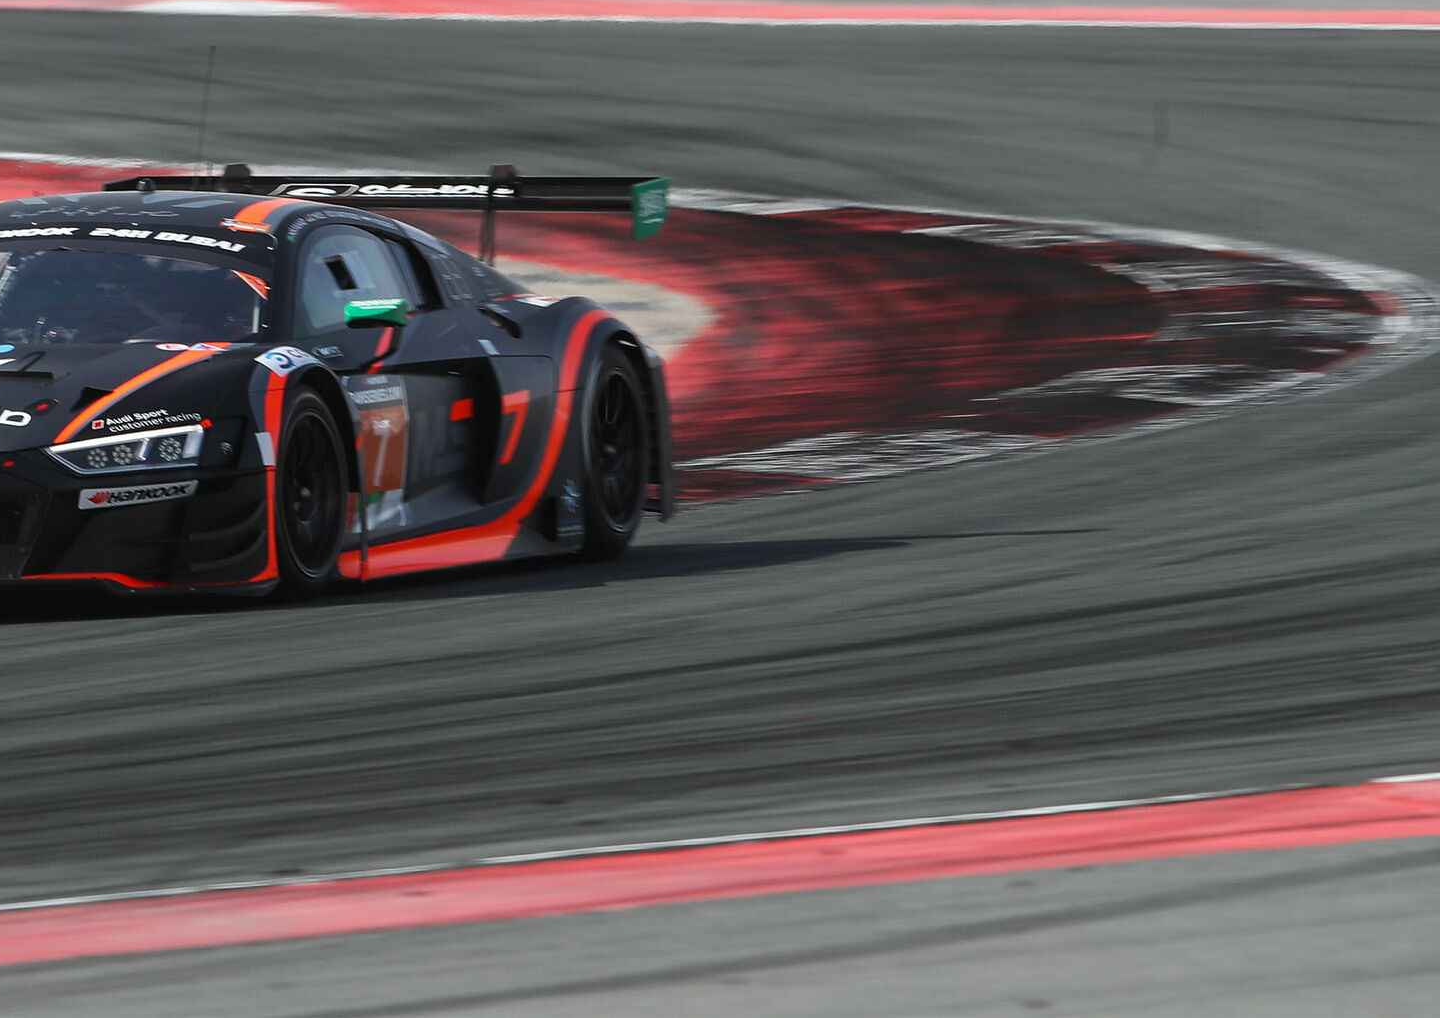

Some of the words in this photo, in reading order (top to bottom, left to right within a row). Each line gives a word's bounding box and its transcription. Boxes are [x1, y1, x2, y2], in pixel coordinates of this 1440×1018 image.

[89, 227, 153, 239] 24H
[153, 232, 246, 252] DUBAI
[106, 414, 133, 426] Audi
[133, 409, 169, 421] Sport
[109, 418, 165, 433] customer
[167, 412, 202, 424] racing
